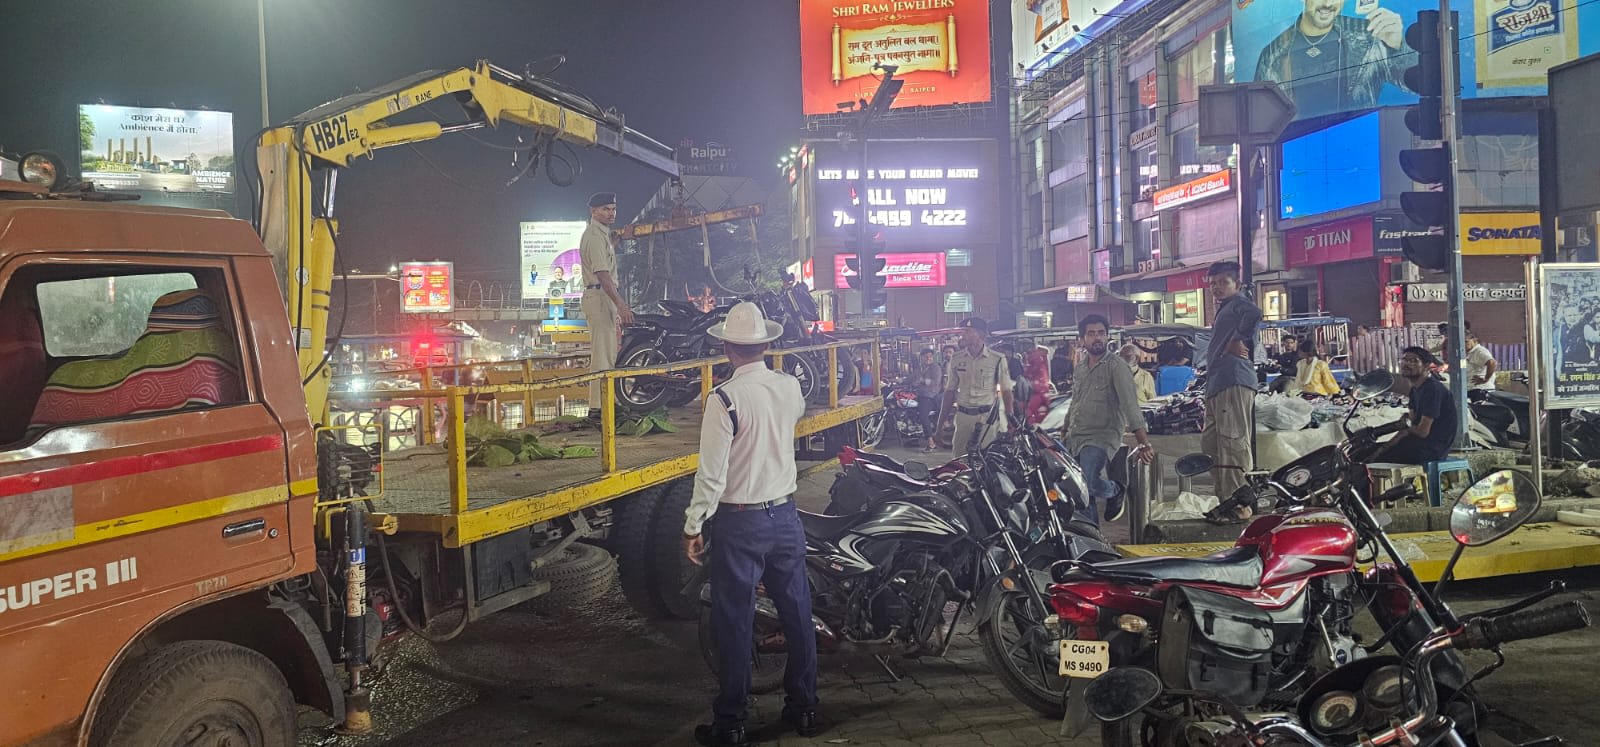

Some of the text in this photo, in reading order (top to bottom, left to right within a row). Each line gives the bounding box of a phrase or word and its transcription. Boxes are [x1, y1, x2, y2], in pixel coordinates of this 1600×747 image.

[832, 0, 956, 18] SHRI RAM JEWELLERS
[848, 42, 860, 50] राम
[862, 41, 873, 51] दूत
[875, 37, 902, 49] अतुलित
[904, 37, 917, 45] बल
[887, 51, 916, 62] पवनसुत
[119, 123, 165, 132] Ambience
[192, 170, 231, 178] AMBIENCE
[818, 169, 842, 180] LETS
[846, 169, 875, 180] MAE
[879, 169, 906, 179] YOUR
[905, 188, 947, 205] NOW
[921, 209, 967, 226] 4222
[1318, 229, 1351, 247] TITAN
[1467, 225, 1542, 242] SONATA
[1071, 644, 1096, 654] CG04
[1064, 661, 1103, 672] MS 9490
